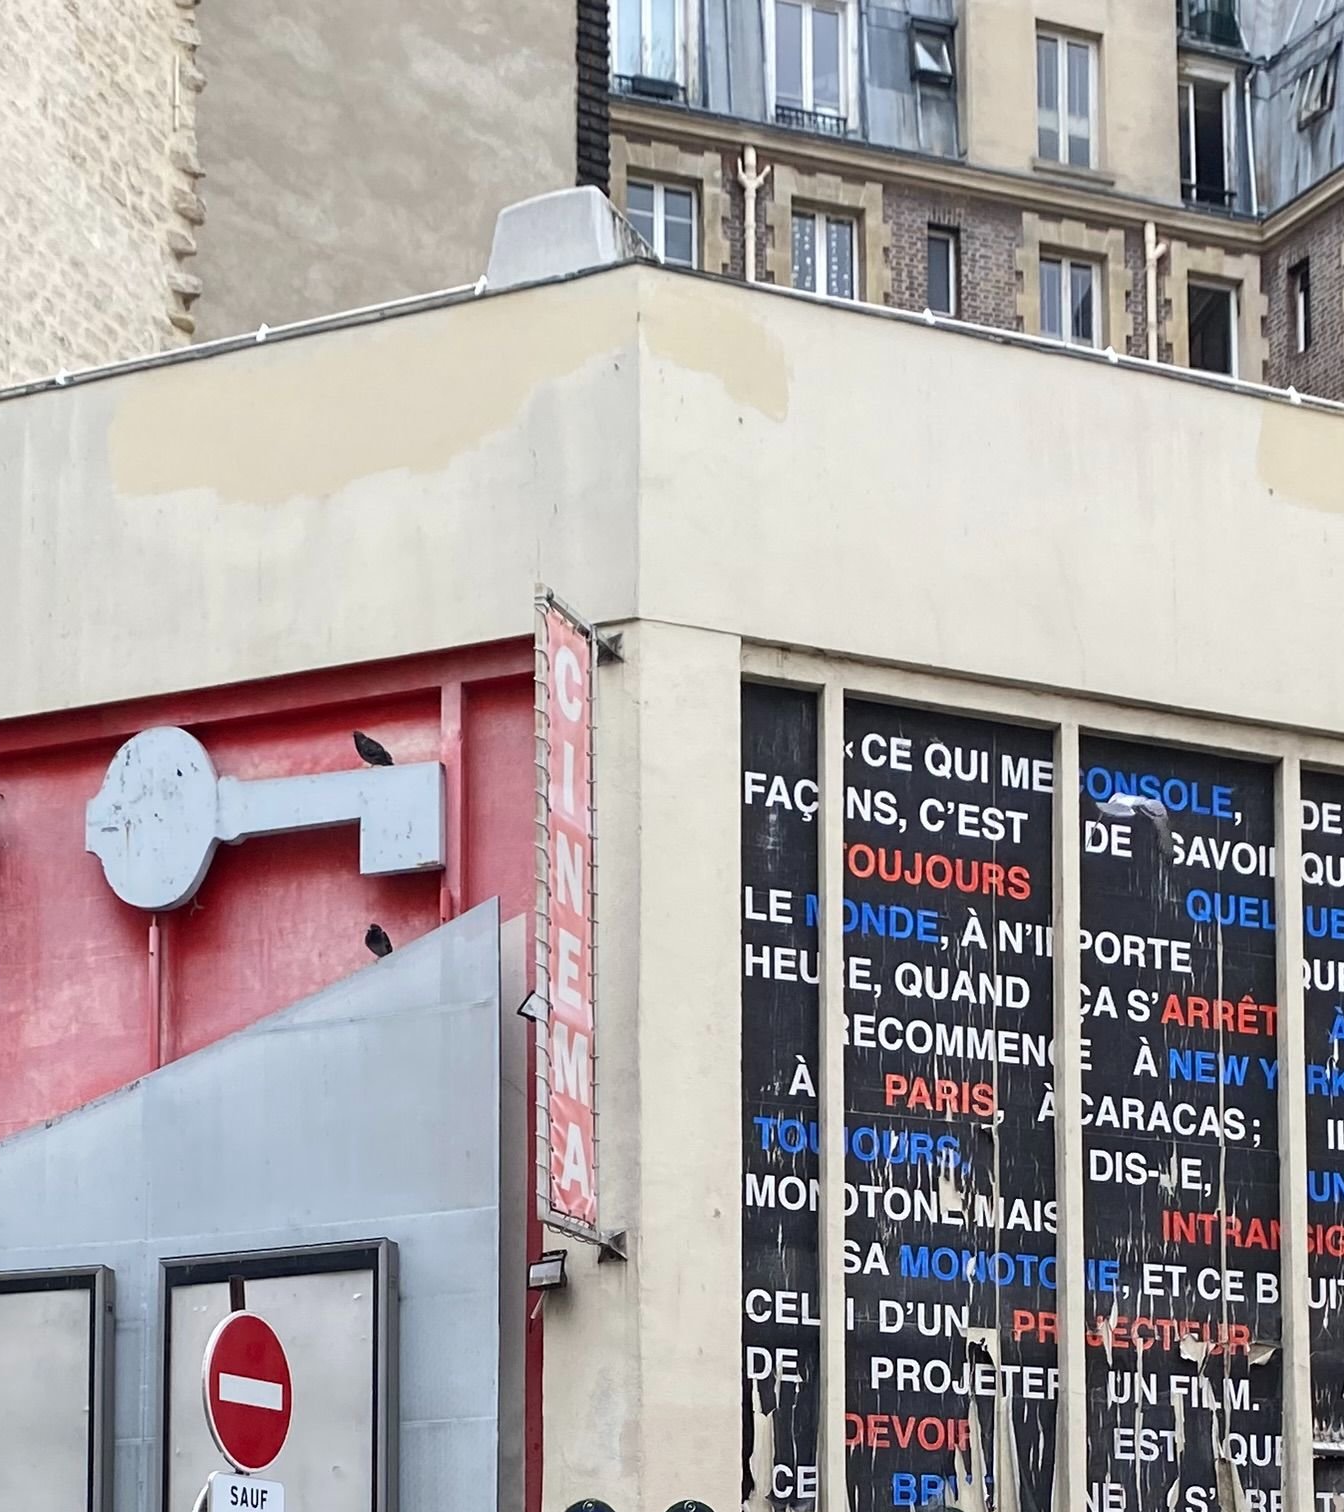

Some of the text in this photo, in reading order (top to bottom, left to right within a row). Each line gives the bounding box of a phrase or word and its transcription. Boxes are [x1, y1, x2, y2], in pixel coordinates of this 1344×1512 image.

[861, 733, 913, 771] CE
[924, 742, 989, 784] QUI
[1001, 756, 1055, 794] ME
[1080, 767, 1242, 827] ONSOLE,
[1301, 800, 1343, 836] DE
[744, 771, 907, 833] FAÇNS,
[919, 798, 1029, 844] C'EST
[1085, 820, 1133, 858] DE
[1172, 831, 1275, 879] SAVOI
[844, 843, 1032, 900] OUJOURS
[554, 642, 592, 1201] CINEMA
[744, 886, 793, 924] LE
[961, 906, 987, 950] À
[998, 919, 1193, 974] N'IPORTE
[744, 943, 883, 998] HEUE,
[894, 961, 1031, 1010] QUAND
[1127, 989, 1278, 1037] S'ARRÊT
[843, 1012, 1093, 1071] ECOMMENE
[1133, 1036, 1159, 1078] À
[1169, 1048, 1250, 1087] NEW
[788, 1054, 816, 1098] À
[884, 1072, 1005, 1125] PARIS,
[752, 1116, 972, 1176] TOUOURS,
[1089, 1148, 1213, 1198] DIS-E,
[976, 1193, 1058, 1233] MAIS
[1142, 1263, 1187, 1298] ET
[1196, 1267, 1245, 1303] CE
[745, 1288, 855, 1332] CELI
[878, 1299, 970, 1338] D'UN
[1013, 1309, 1251, 1357] PRJECTEUR
[746, 1346, 804, 1383] DE
[1108, 1370, 1158, 1405] UN
[1113, 1427, 1178, 1463] EST
[229, 1485, 269, 1510] SAUF
[771, 1463, 818, 1499] CE
